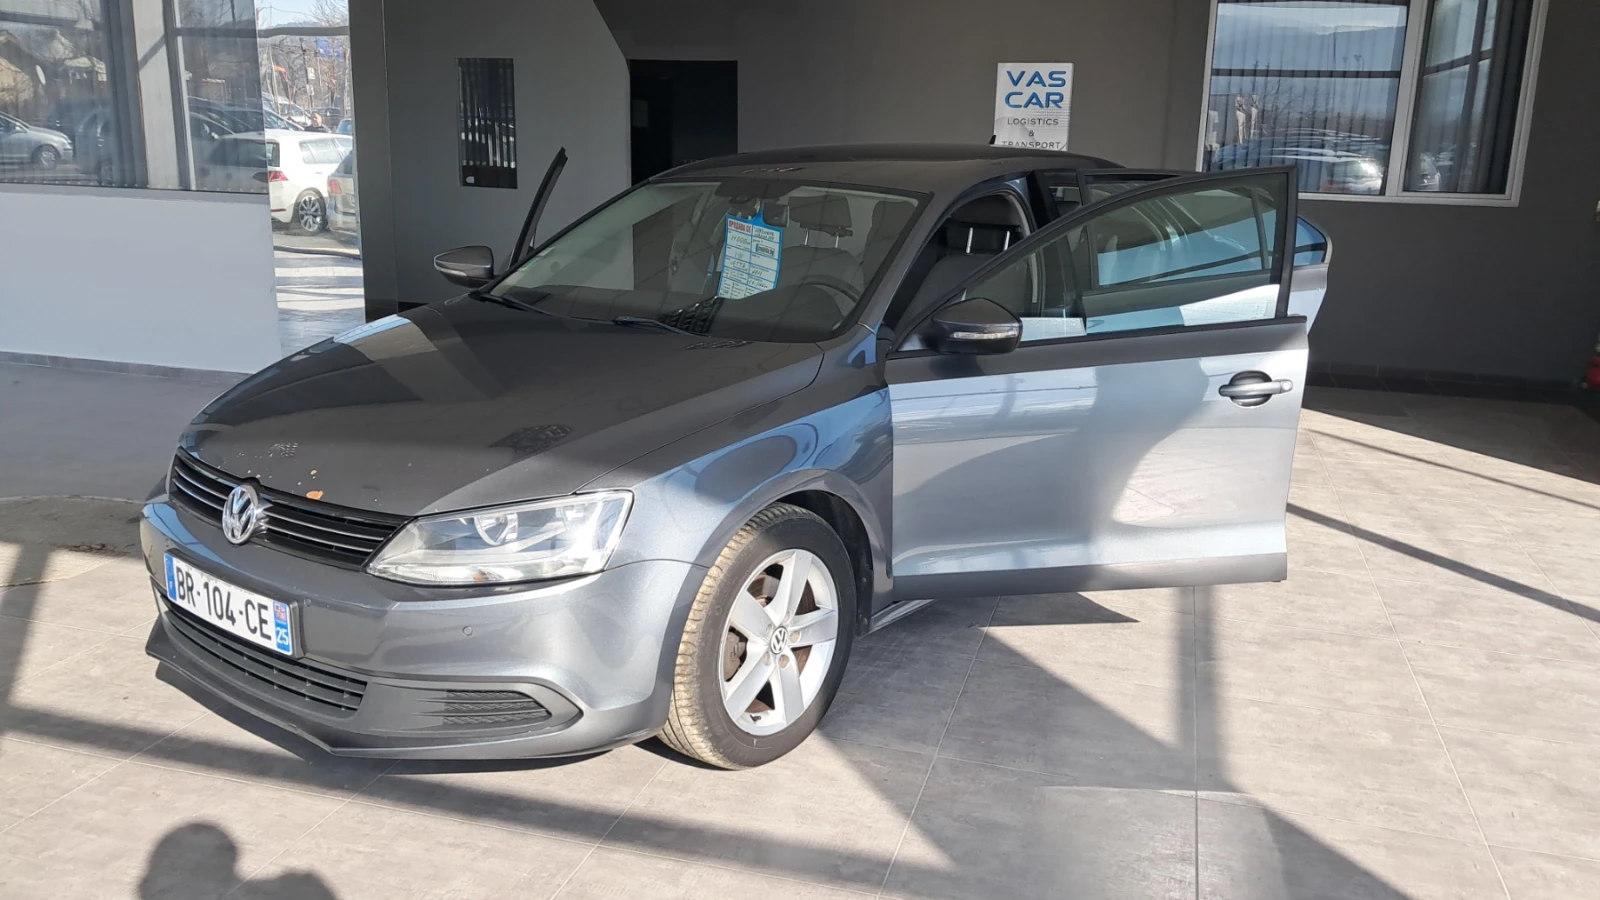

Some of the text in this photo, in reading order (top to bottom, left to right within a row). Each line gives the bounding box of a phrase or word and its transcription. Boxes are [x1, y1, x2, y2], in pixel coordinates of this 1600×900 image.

[1006, 70, 1067, 88] VAS
[1004, 91, 1064, 109] CAR
[1007, 117, 1059, 126] LOGISTICS
[1002, 140, 1061, 149] TRANSPORT
[175, 565, 272, 641] BR-104-CE
[275, 627, 289, 646] 25
